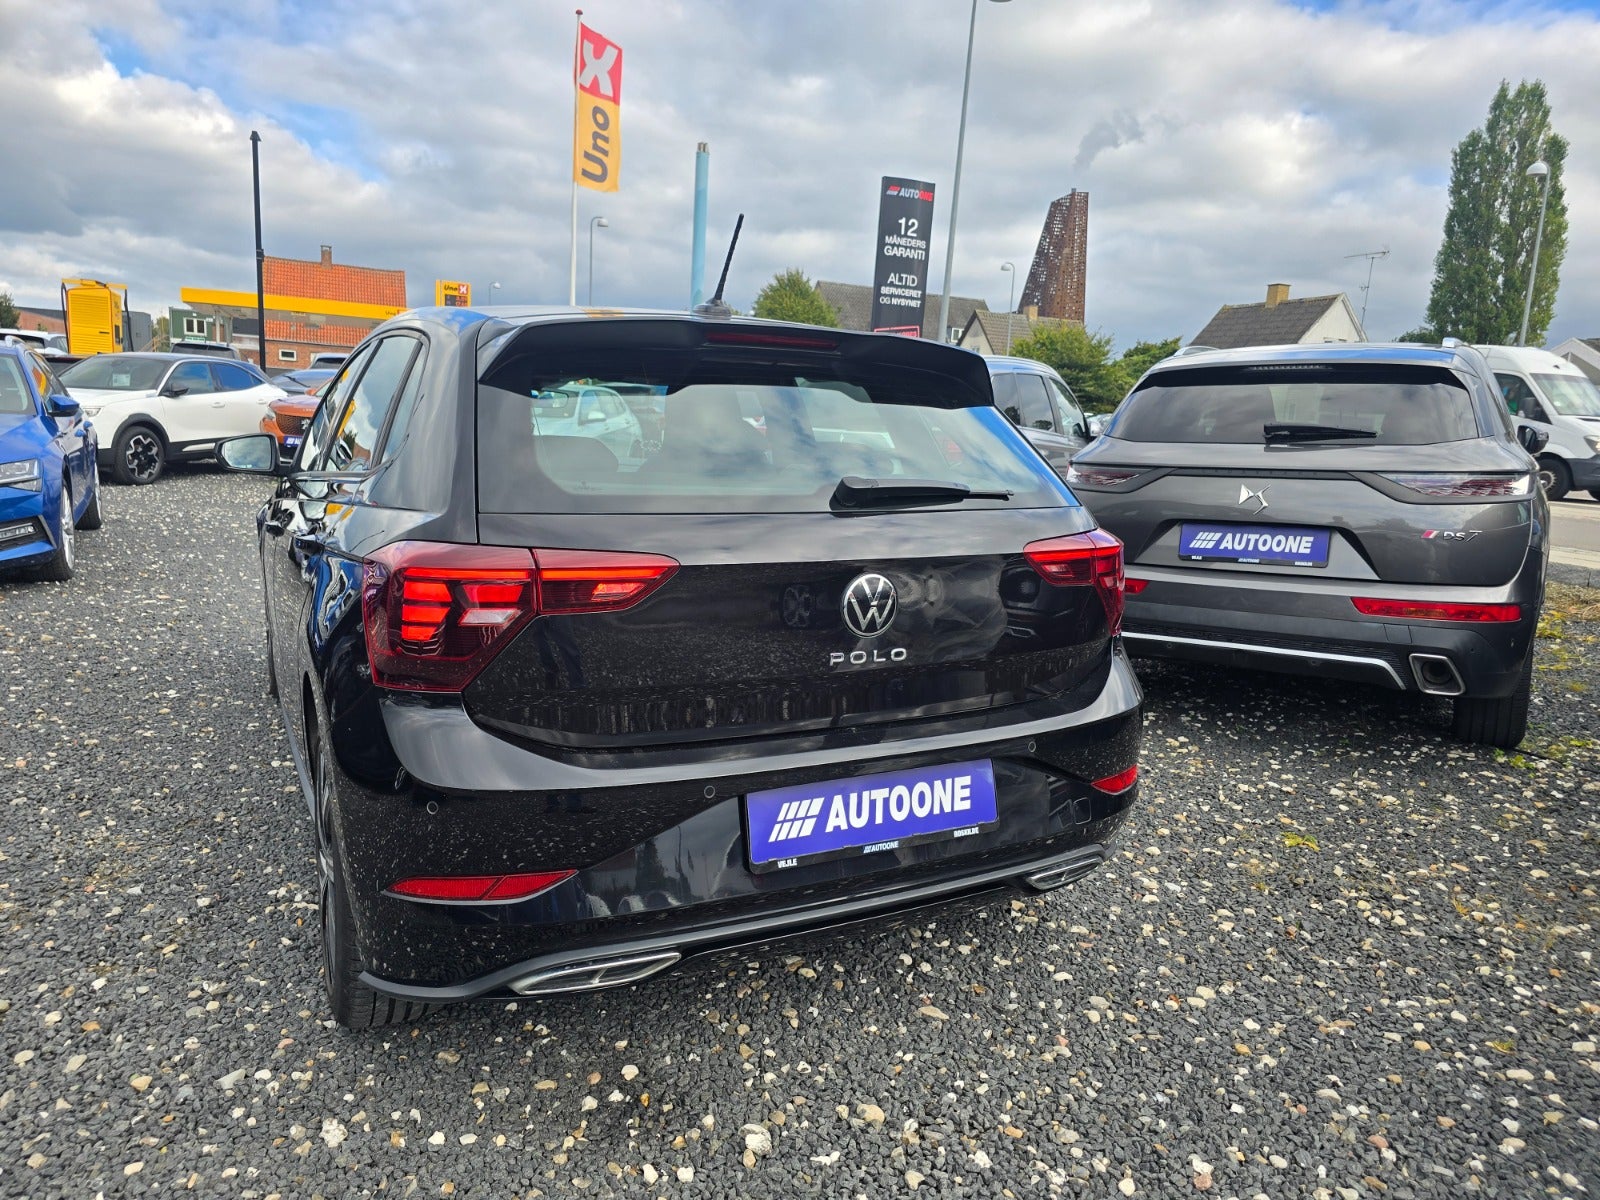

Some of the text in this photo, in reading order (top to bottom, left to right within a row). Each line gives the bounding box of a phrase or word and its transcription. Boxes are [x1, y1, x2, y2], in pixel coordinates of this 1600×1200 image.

[579, 39, 619, 183] Uno X
[898, 216, 918, 237] 12
[885, 234, 926, 249] MÅNEDERS
[884, 245, 925, 260] GARANTI
[887, 272, 918, 287] ALTID
[880, 286, 922, 298] SERVICERET
[879, 296, 921, 308] OG NYSYNET
[1219, 532, 1314, 554] AUTOONE
[829, 647, 907, 666] POLO
[825, 775, 972, 833] AUTOONE
[871, 840, 899, 852] AUTOONE
[777, 857, 798, 869] VEJLE
